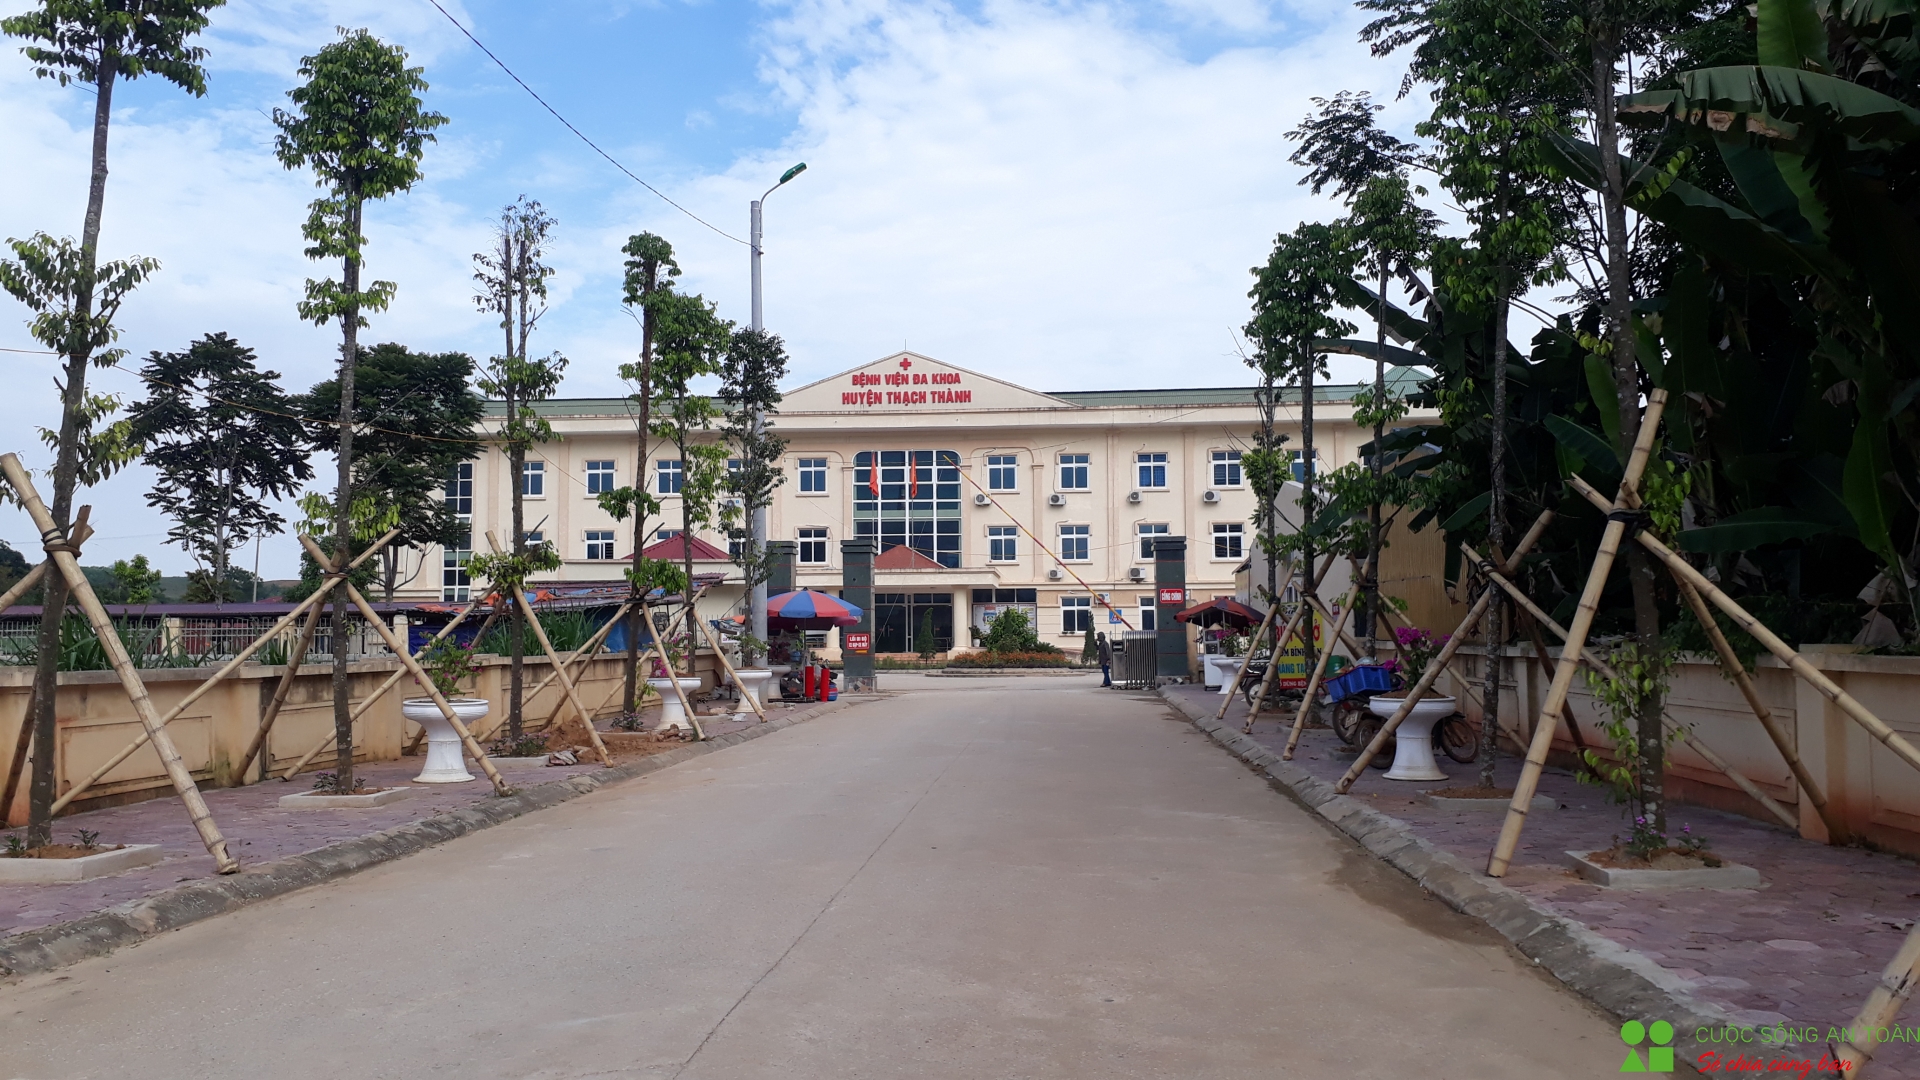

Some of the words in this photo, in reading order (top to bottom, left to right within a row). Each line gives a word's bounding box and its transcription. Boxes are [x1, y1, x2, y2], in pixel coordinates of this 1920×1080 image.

[852, 372, 881, 388] BỆNH
[885, 372, 909, 387] VIỆN
[913, 373, 928, 385] ĐA
[932, 373, 961, 385] KHOA
[842, 389, 882, 407] HUYỆN
[886, 391, 927, 406] THẠCH
[930, 388, 971, 404] THÀNH
